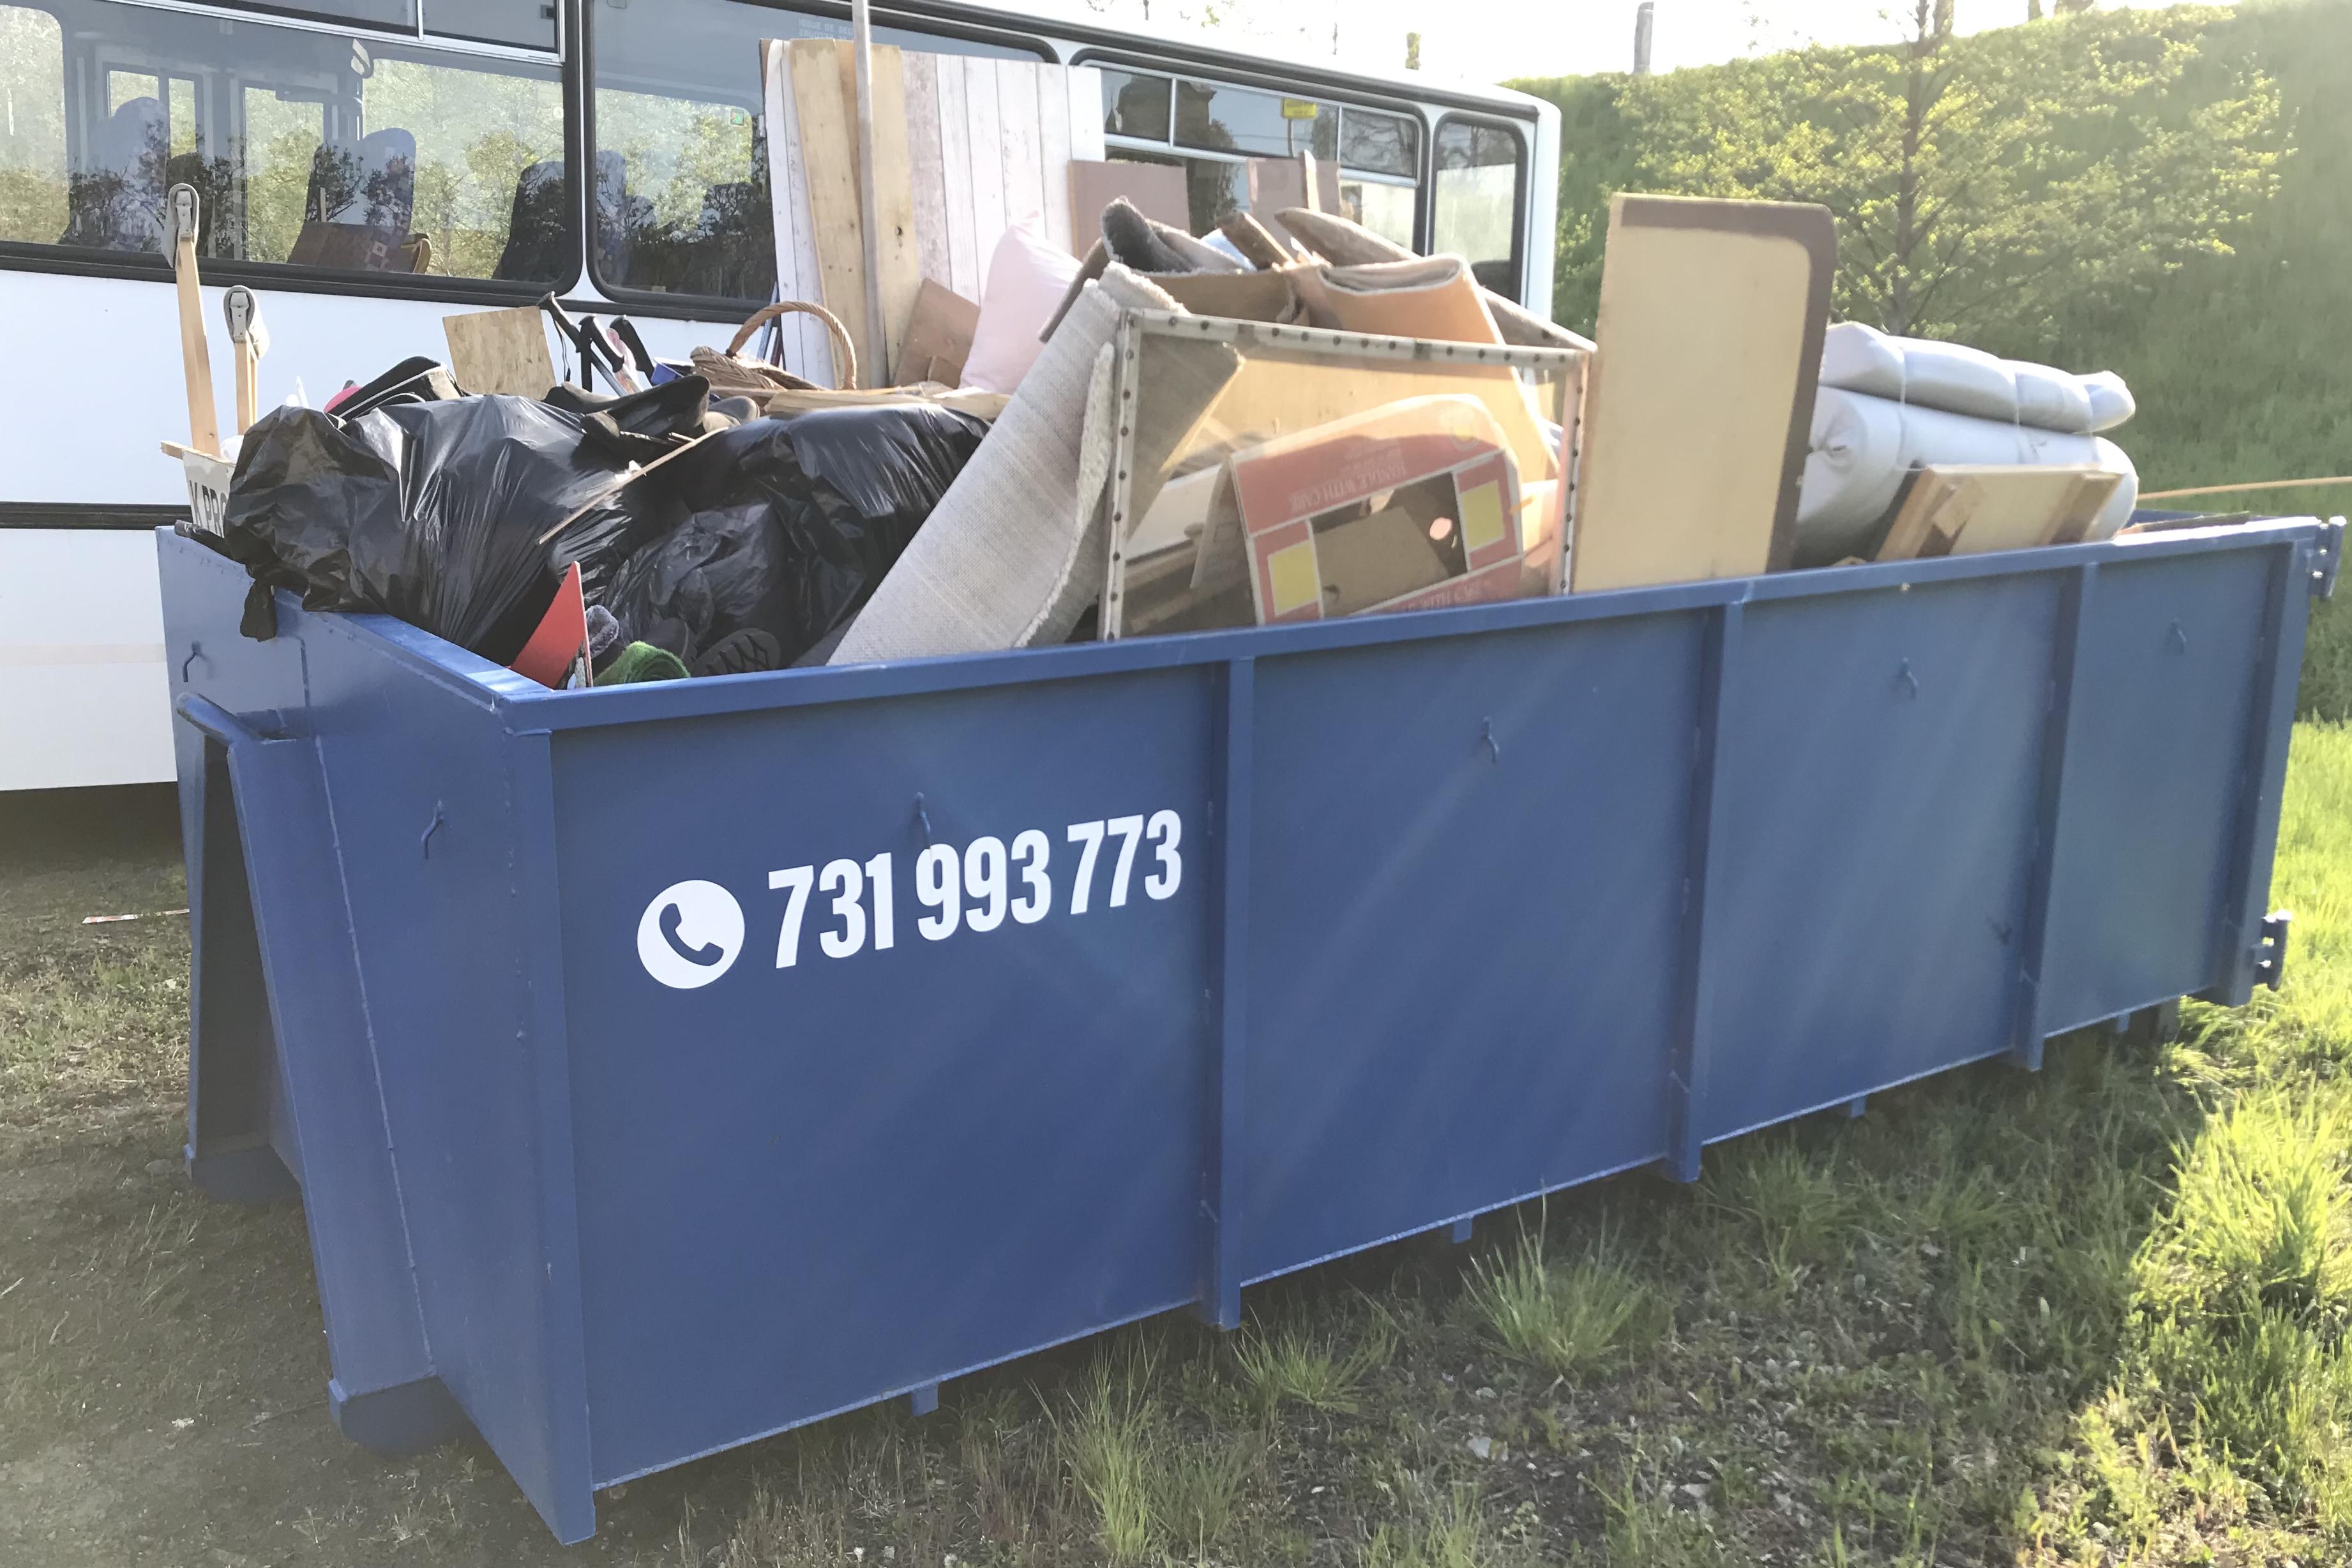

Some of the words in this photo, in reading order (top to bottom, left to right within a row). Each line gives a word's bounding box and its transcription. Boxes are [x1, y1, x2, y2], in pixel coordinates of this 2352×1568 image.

[767, 851, 895, 969] 731
[915, 829, 1052, 942] 993
[1066, 808, 1183, 916] 773
